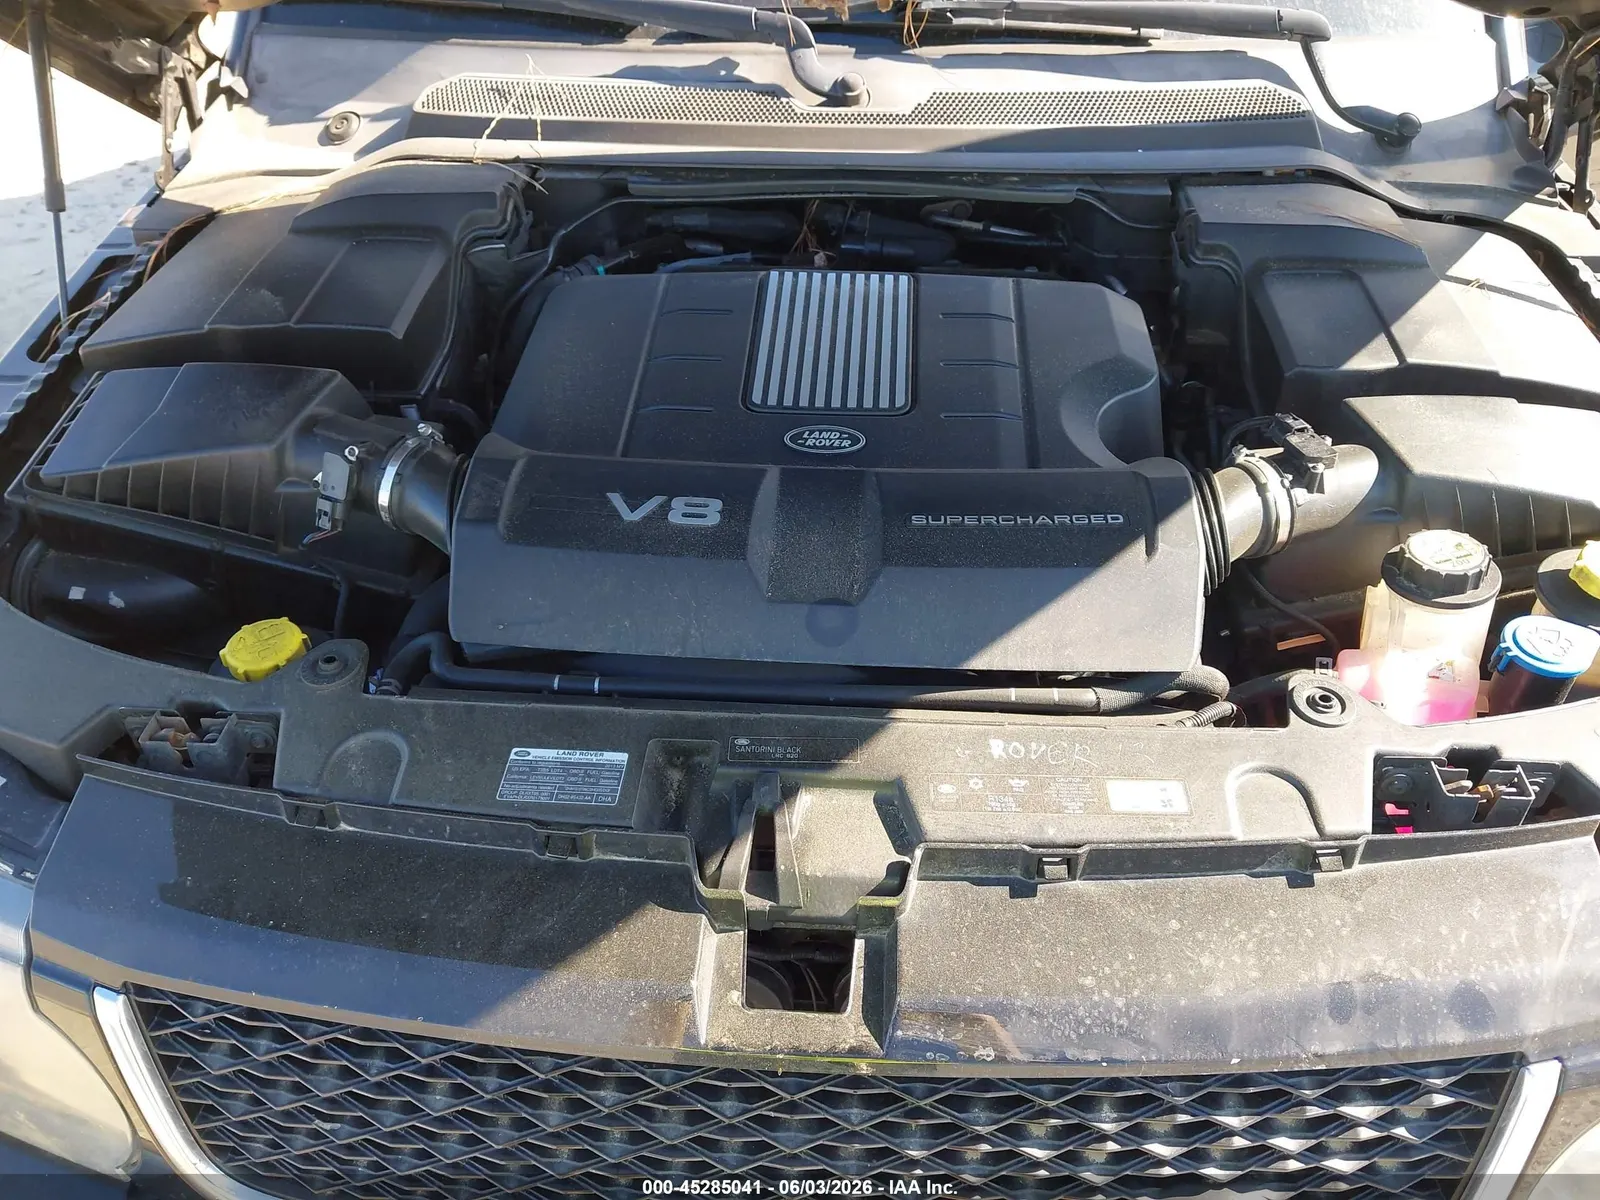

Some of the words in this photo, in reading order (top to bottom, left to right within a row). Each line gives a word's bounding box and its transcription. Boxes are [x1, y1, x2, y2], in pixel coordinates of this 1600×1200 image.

[606, 492, 723, 525] V8
[911, 514, 1124, 525] SUPERCHARGED
[735, 745, 775, 753] SANTORINI
[989, 739, 1098, 767] ROVER
